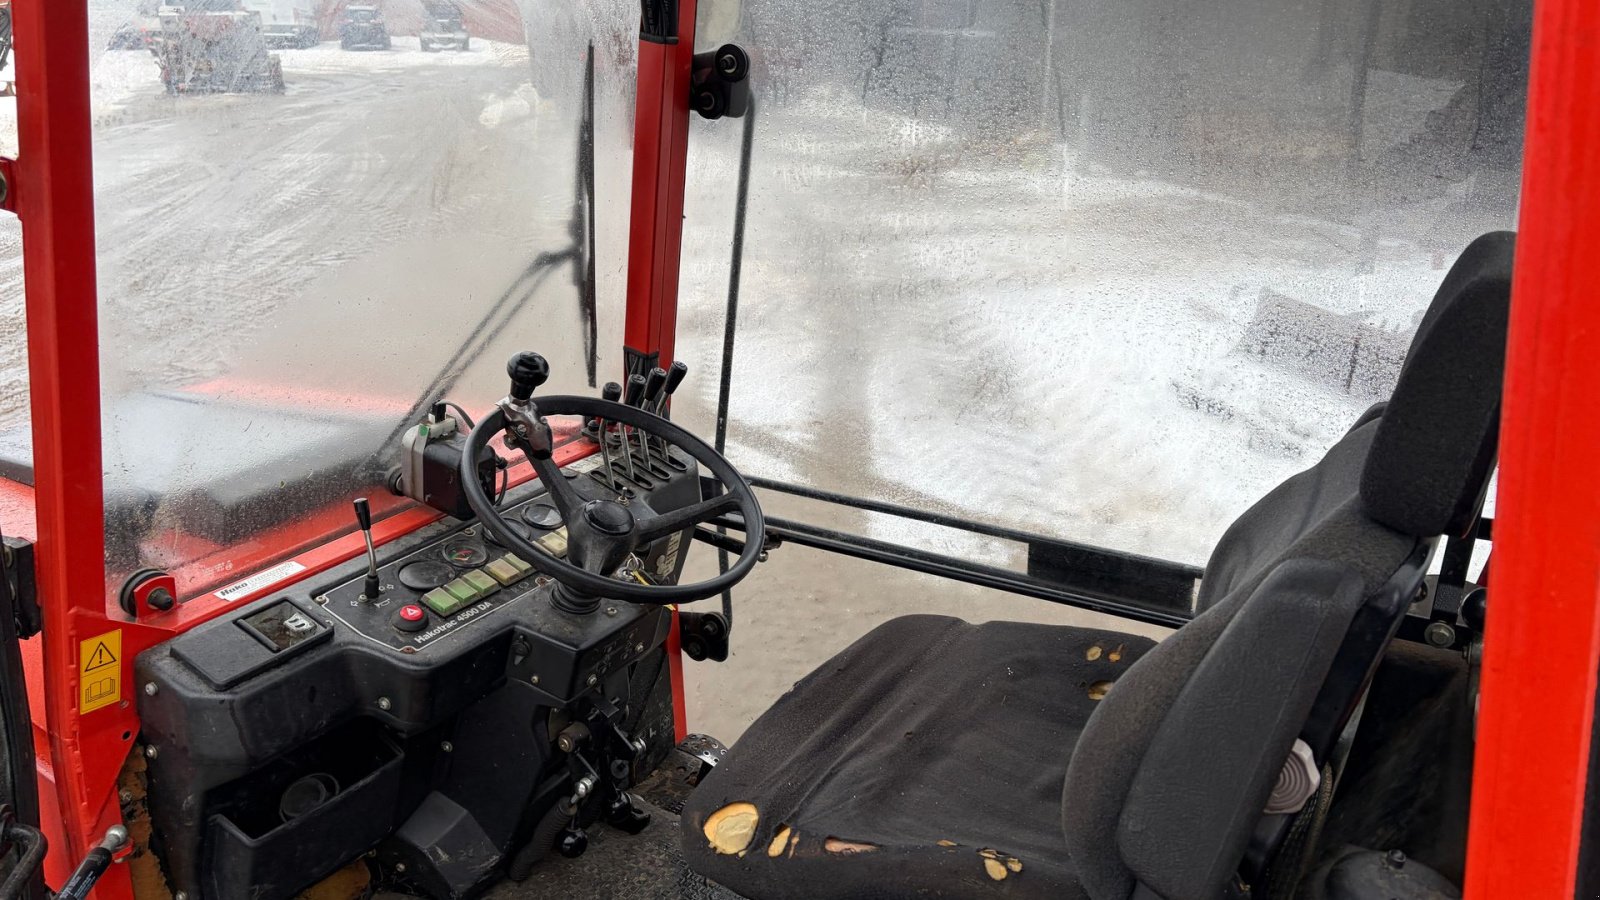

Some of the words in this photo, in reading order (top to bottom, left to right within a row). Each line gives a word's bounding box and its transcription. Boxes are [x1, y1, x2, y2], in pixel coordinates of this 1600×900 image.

[220, 582, 248, 596] Hako
[414, 620, 458, 643] Hakotrac
[456, 607, 479, 622] 4500
[477, 601, 493, 611] DA
